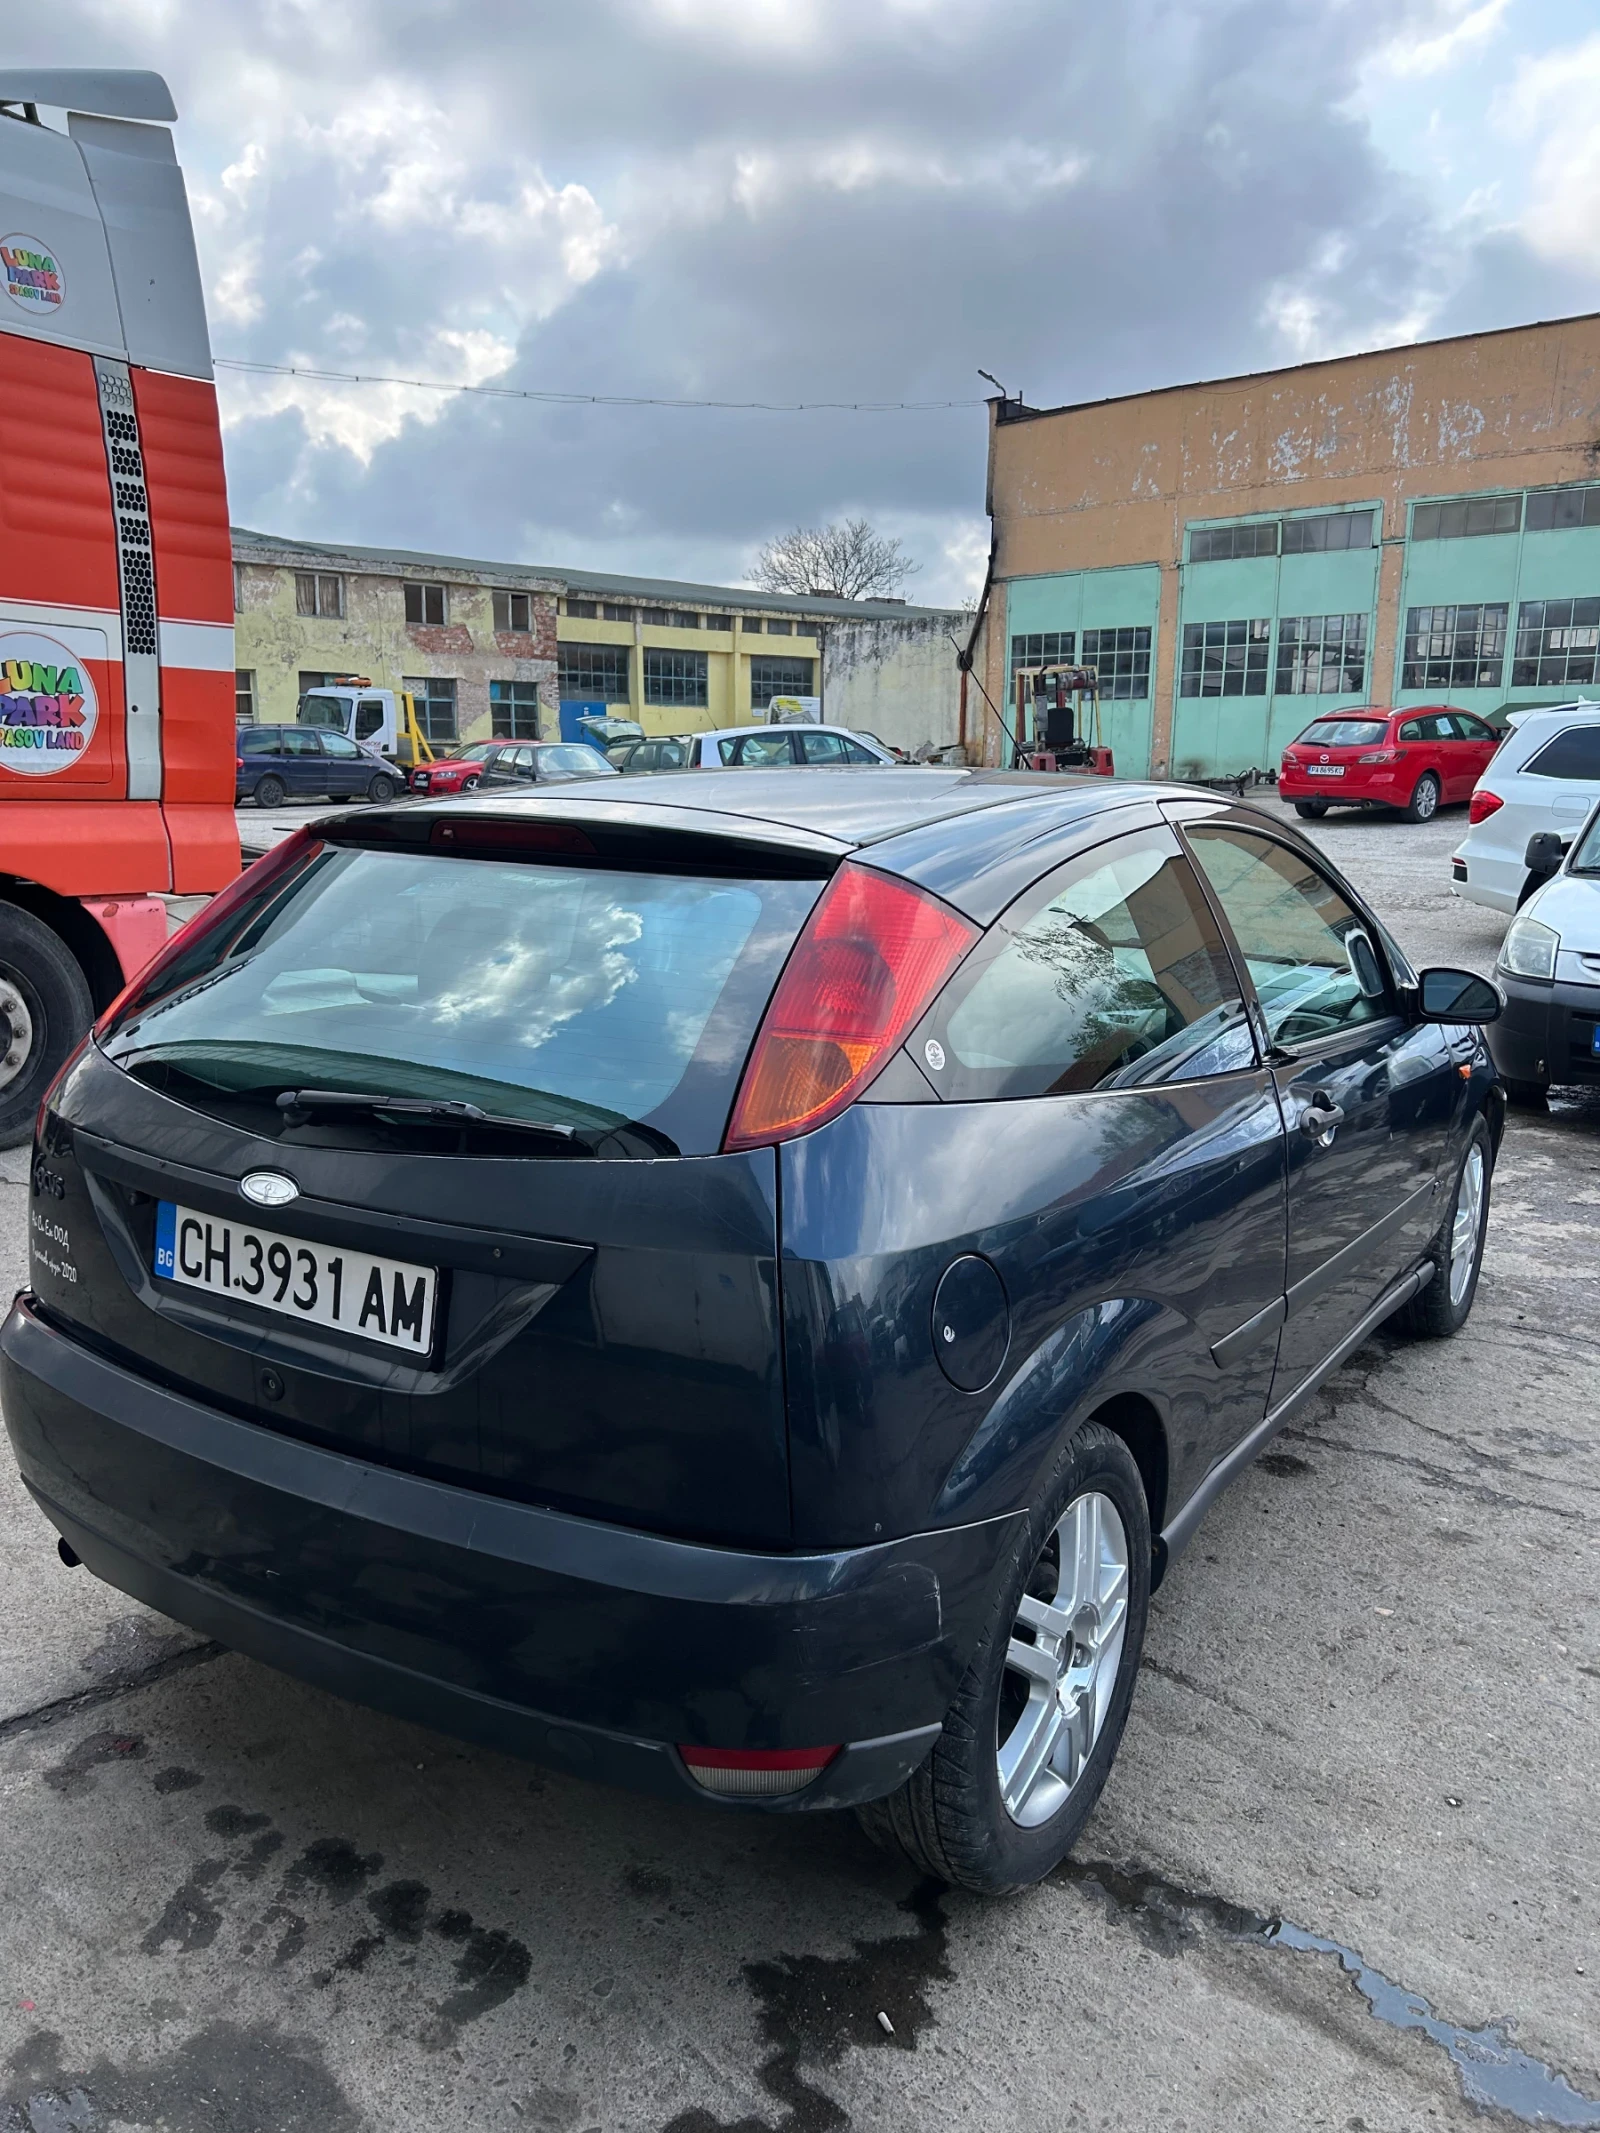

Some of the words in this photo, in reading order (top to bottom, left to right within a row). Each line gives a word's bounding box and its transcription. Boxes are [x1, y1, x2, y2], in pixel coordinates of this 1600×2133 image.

[0, 246, 57, 273] LUNA
[6, 266, 61, 291] PARK
[0, 693, 86, 728] PARK
[0, 727, 45, 749] PASOV
[46, 730, 85, 751] LAND
[157, 1248, 173, 1267] BG
[61, 1261, 77, 1283] 2020
[358, 1266, 426, 1342] AM
